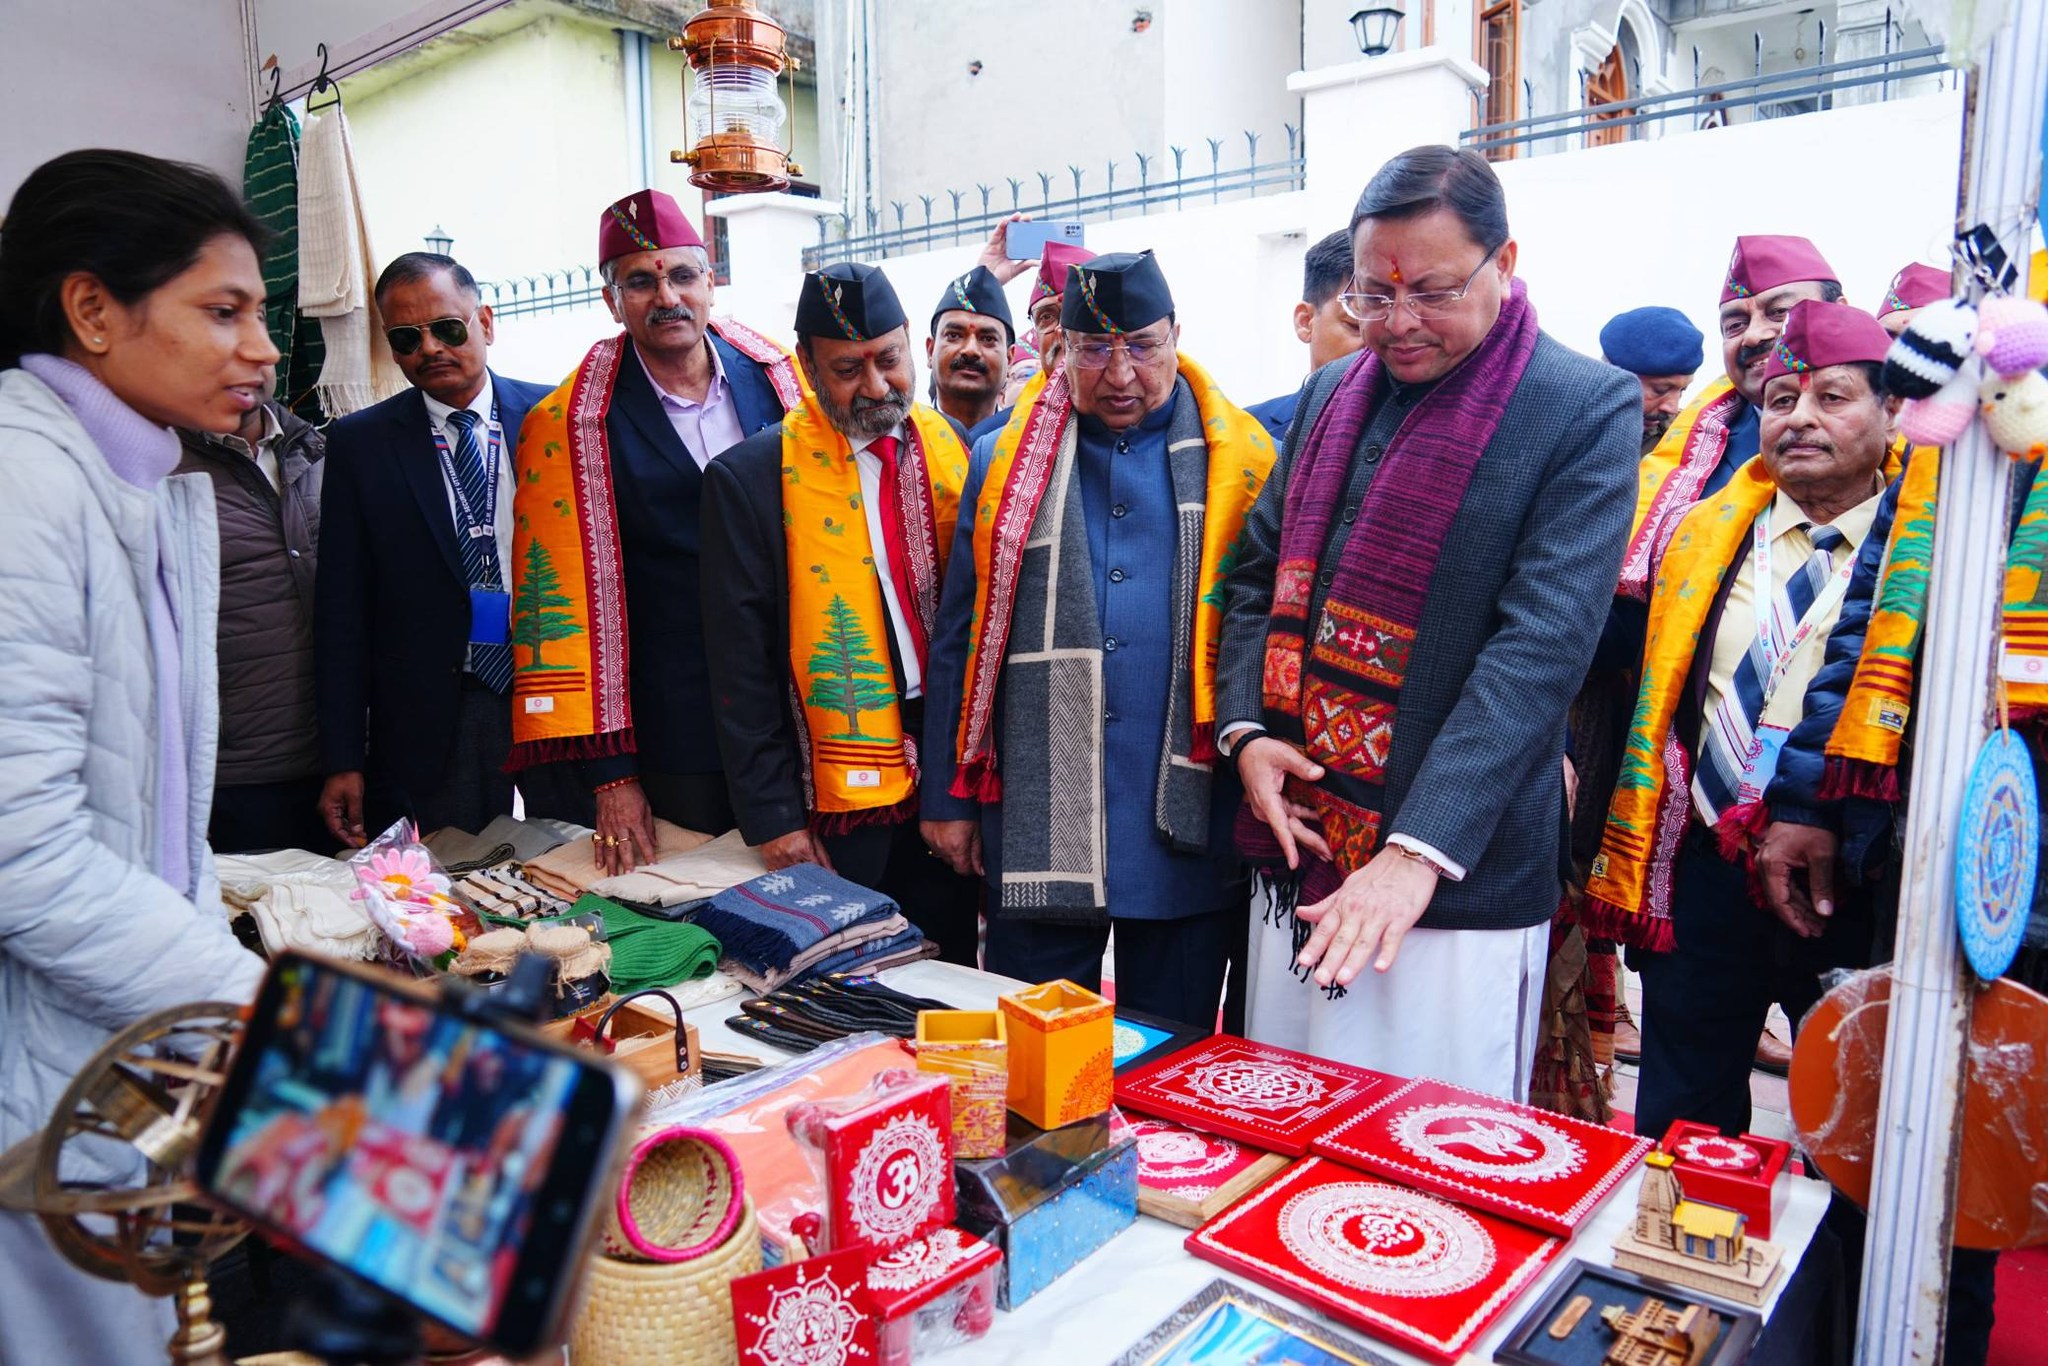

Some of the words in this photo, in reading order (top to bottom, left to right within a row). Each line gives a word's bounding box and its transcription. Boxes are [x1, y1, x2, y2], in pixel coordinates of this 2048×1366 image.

[441, 449, 460, 487] UTTARAKHAND
[488, 444, 497, 484] UTTARAKHAND
[457, 487, 471, 512] SECURITY
[486, 484, 494, 510] SECURITY
